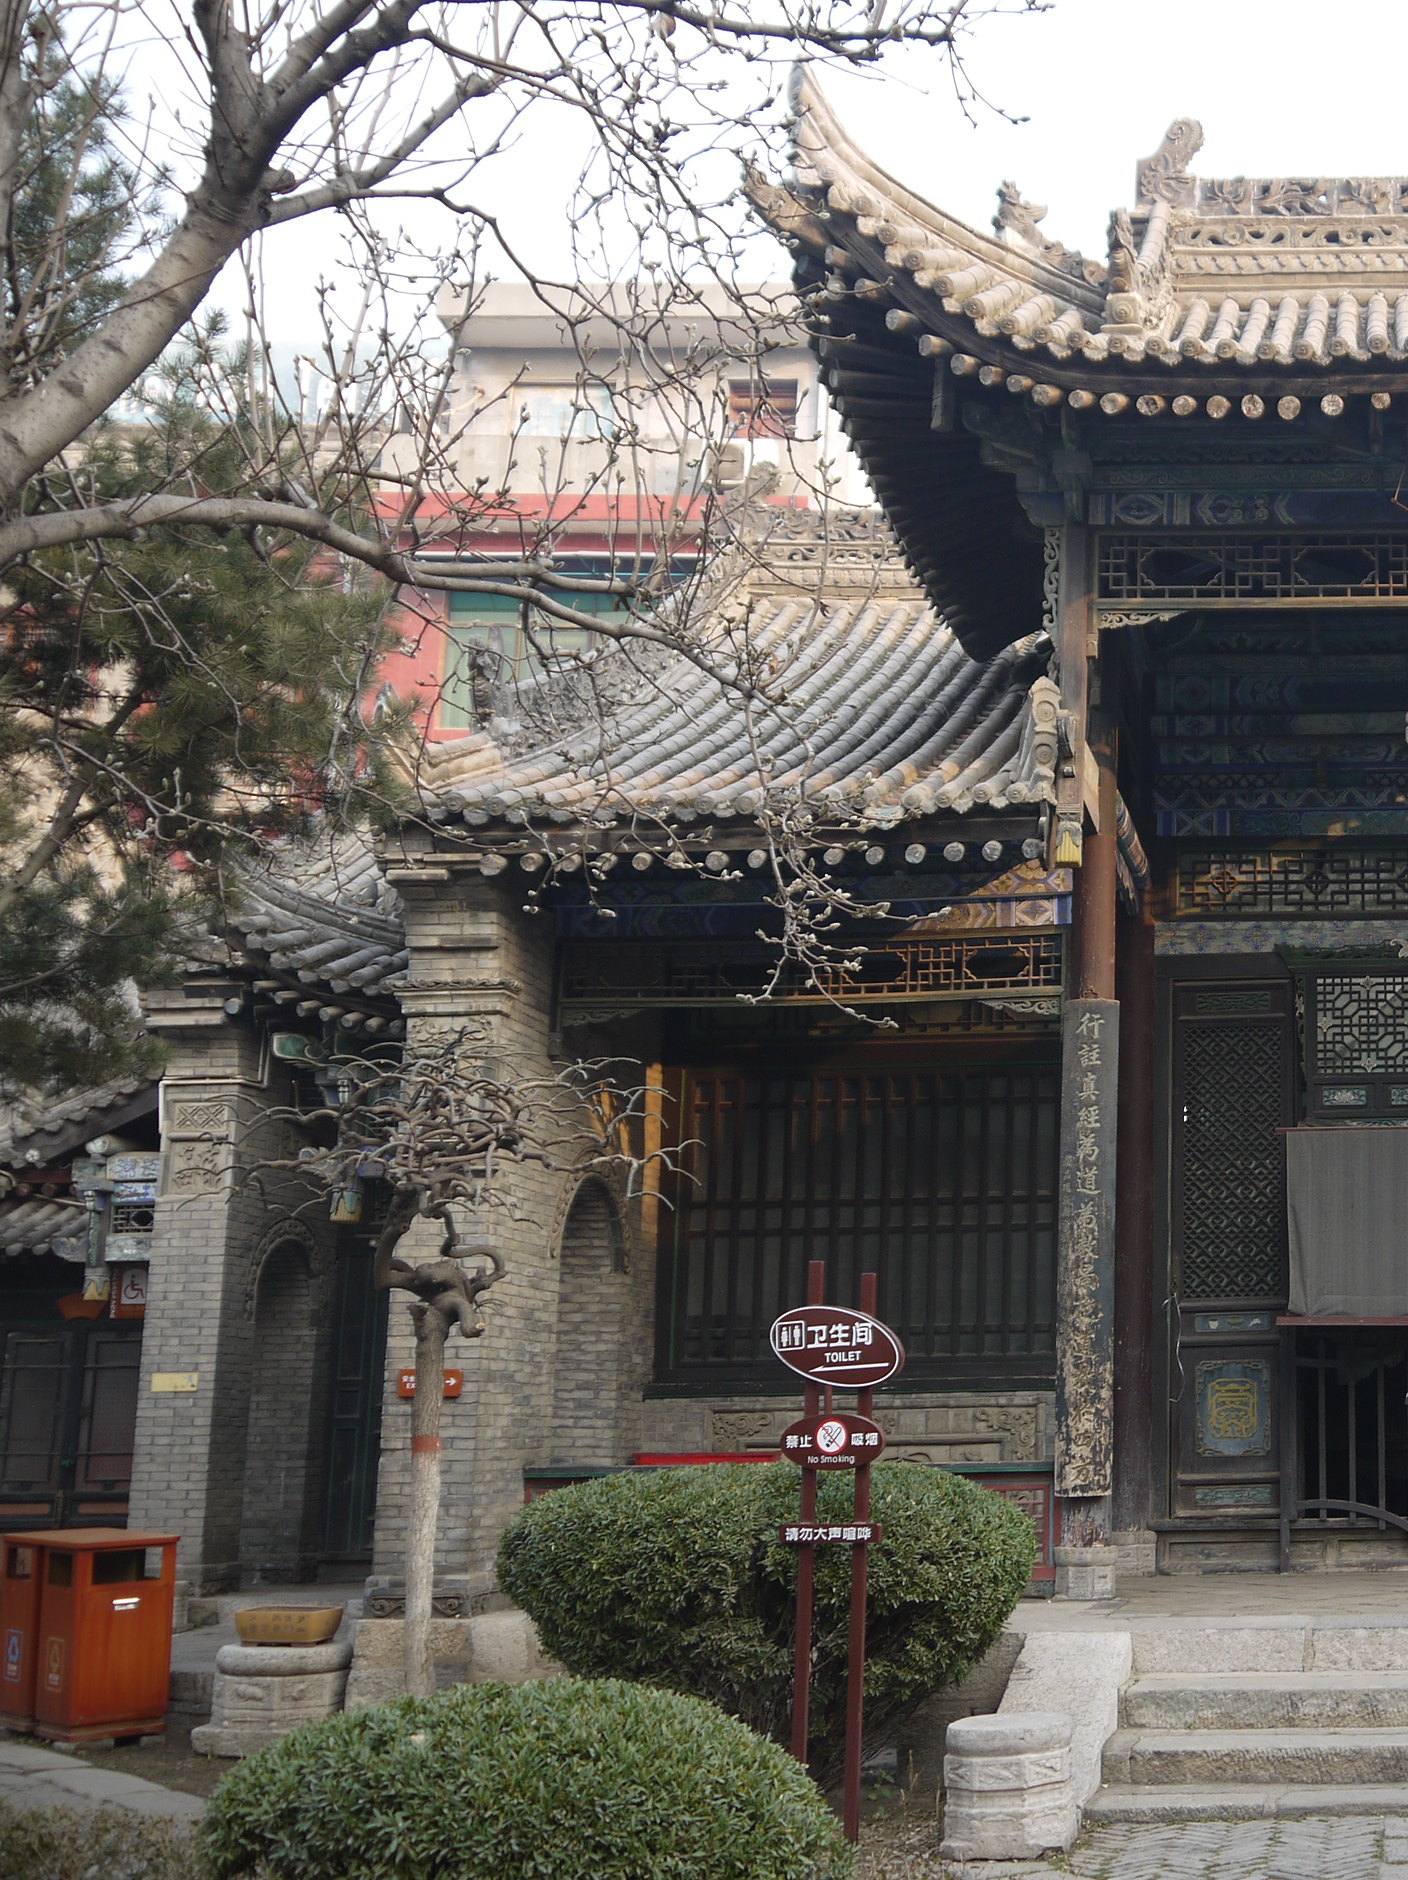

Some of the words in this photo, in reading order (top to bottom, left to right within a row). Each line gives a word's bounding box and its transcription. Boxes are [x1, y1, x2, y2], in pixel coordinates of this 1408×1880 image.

[806, 1322, 873, 1349] 卫生间
[824, 1350, 862, 1363] TOILET
[785, 1434, 813, 1449] 禁止
[850, 1432, 879, 1446] 吸烟
[807, 1455, 819, 1464] No
[820, 1455, 855, 1465] Smoking
[785, 1527, 872, 1541] 请勿大声喧哗
